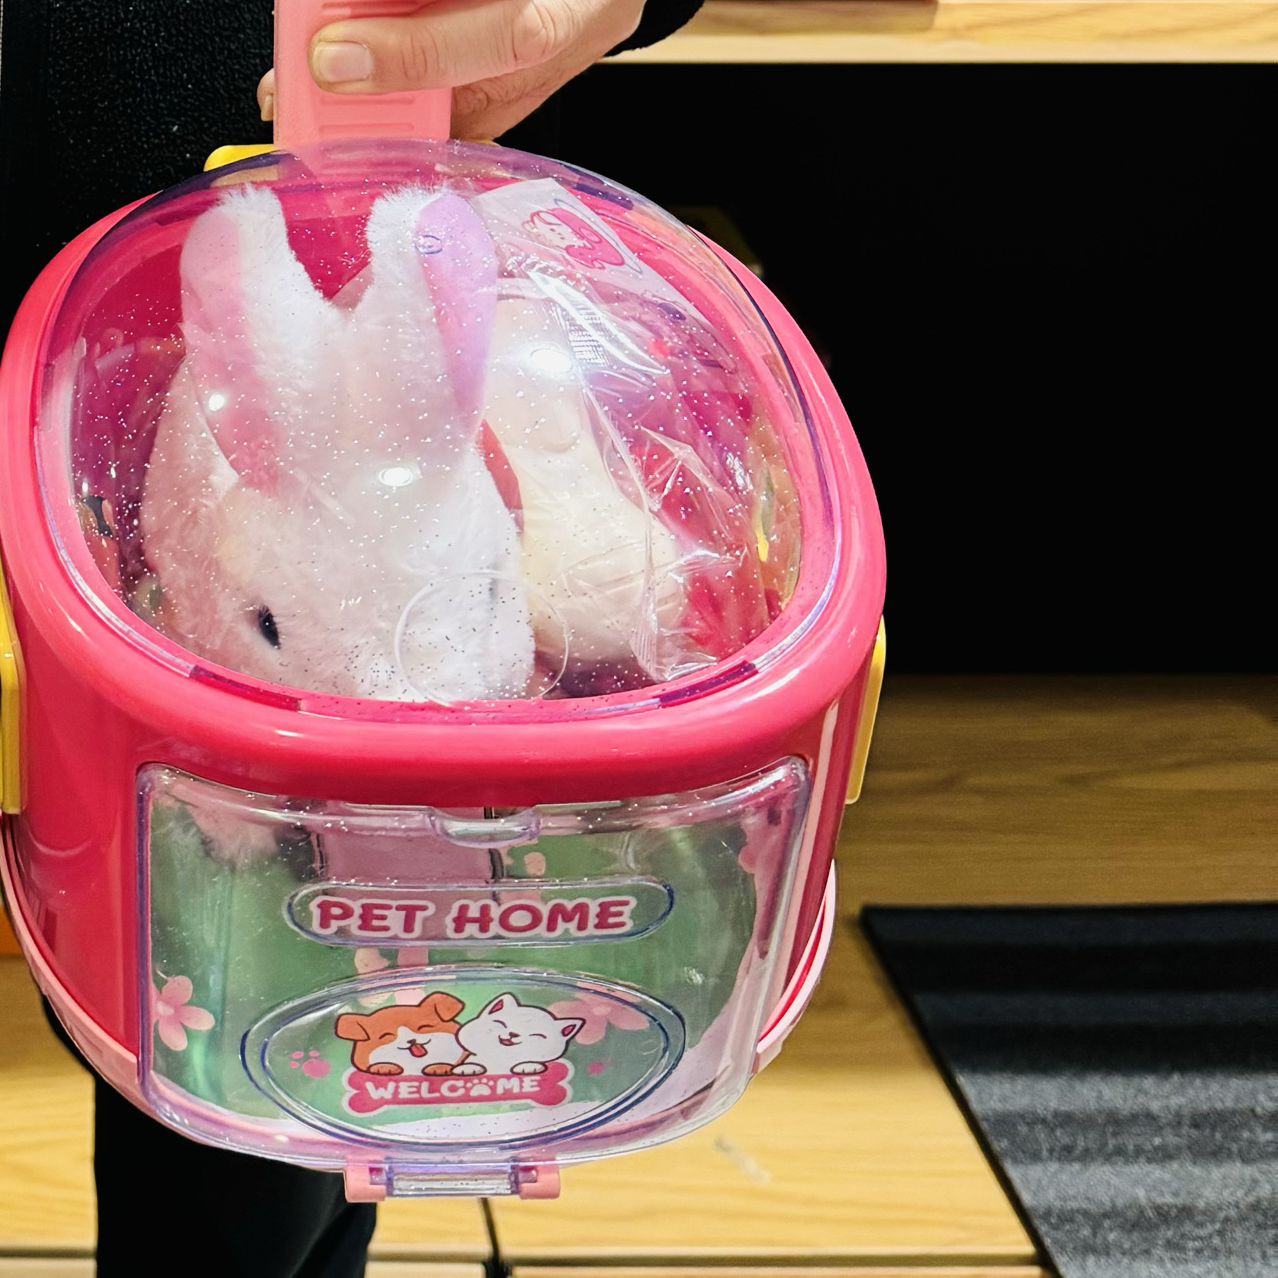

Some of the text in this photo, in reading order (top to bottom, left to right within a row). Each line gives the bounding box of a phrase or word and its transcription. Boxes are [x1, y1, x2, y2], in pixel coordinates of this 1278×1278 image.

[317, 897, 632, 934] PET HOME
[366, 1075, 542, 1100] WELCOME
